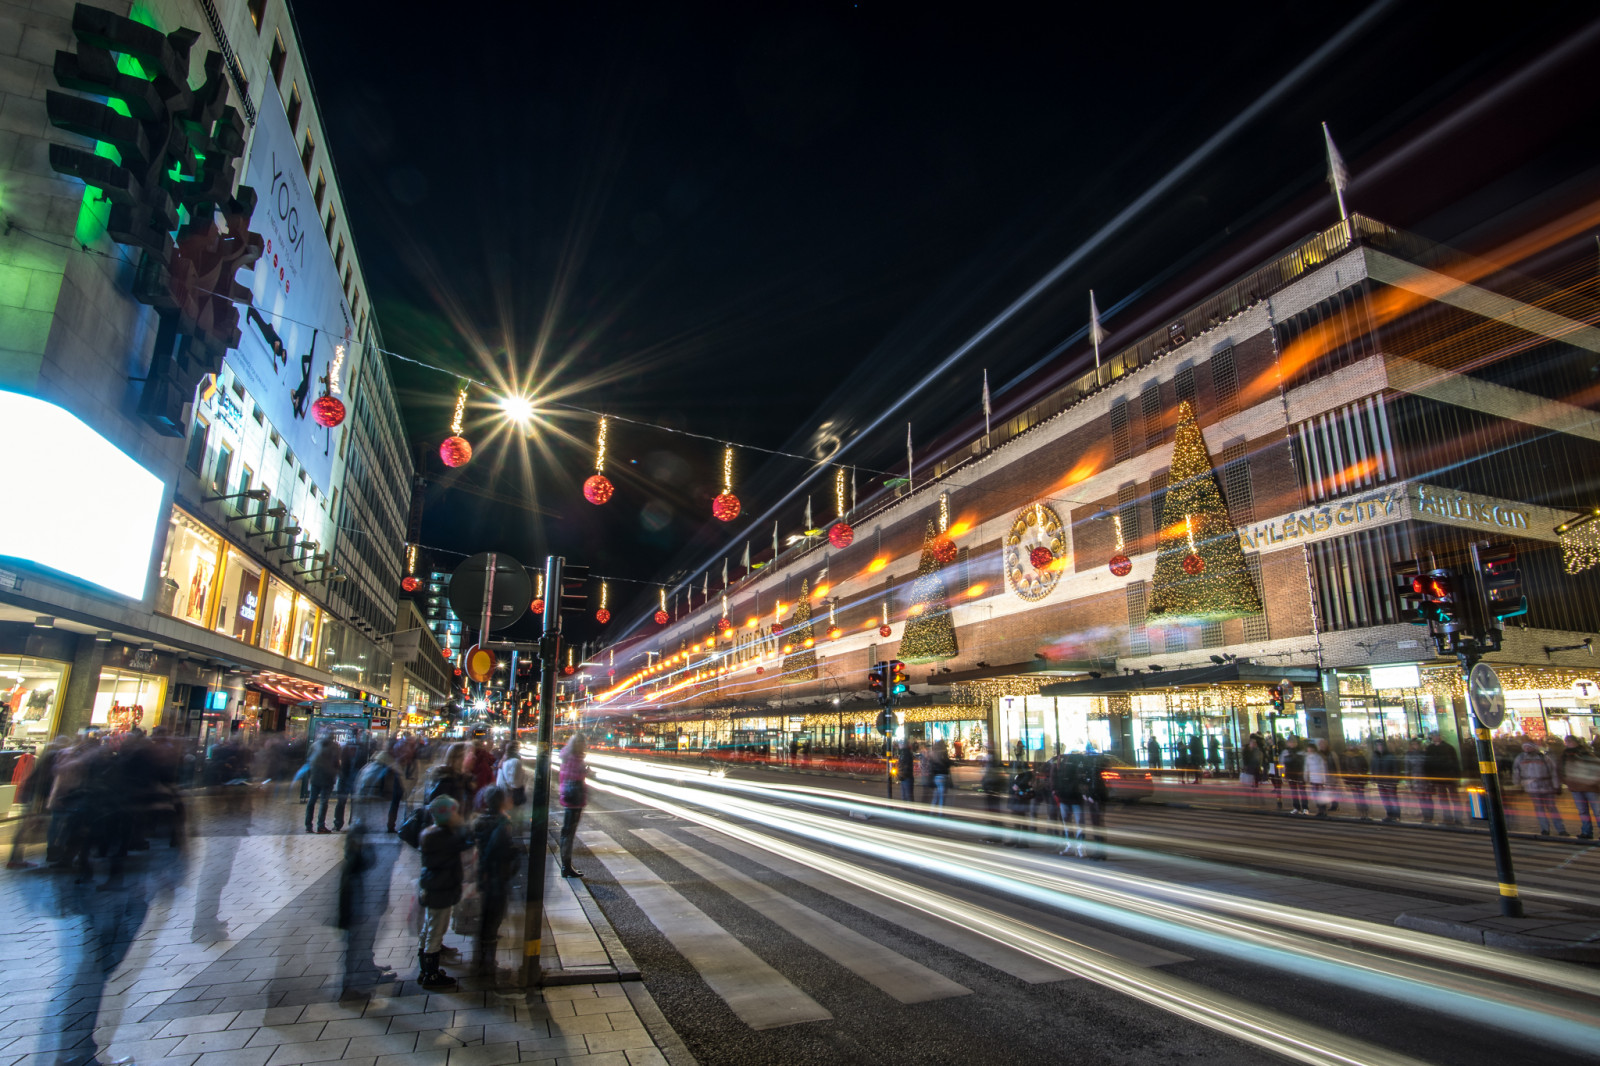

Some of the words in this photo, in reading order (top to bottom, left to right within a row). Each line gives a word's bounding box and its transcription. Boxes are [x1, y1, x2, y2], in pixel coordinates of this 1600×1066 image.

[270, 151, 305, 268] YOGA
[1239, 512, 1330, 553] ÅHLÉNS
[1334, 494, 1393, 527] CITY
[1418, 485, 1494, 525] ÅHLÉNS
[1492, 505, 1531, 530] CITY
[1003, 697, 1014, 709] T
[1575, 682, 1592, 696] T
